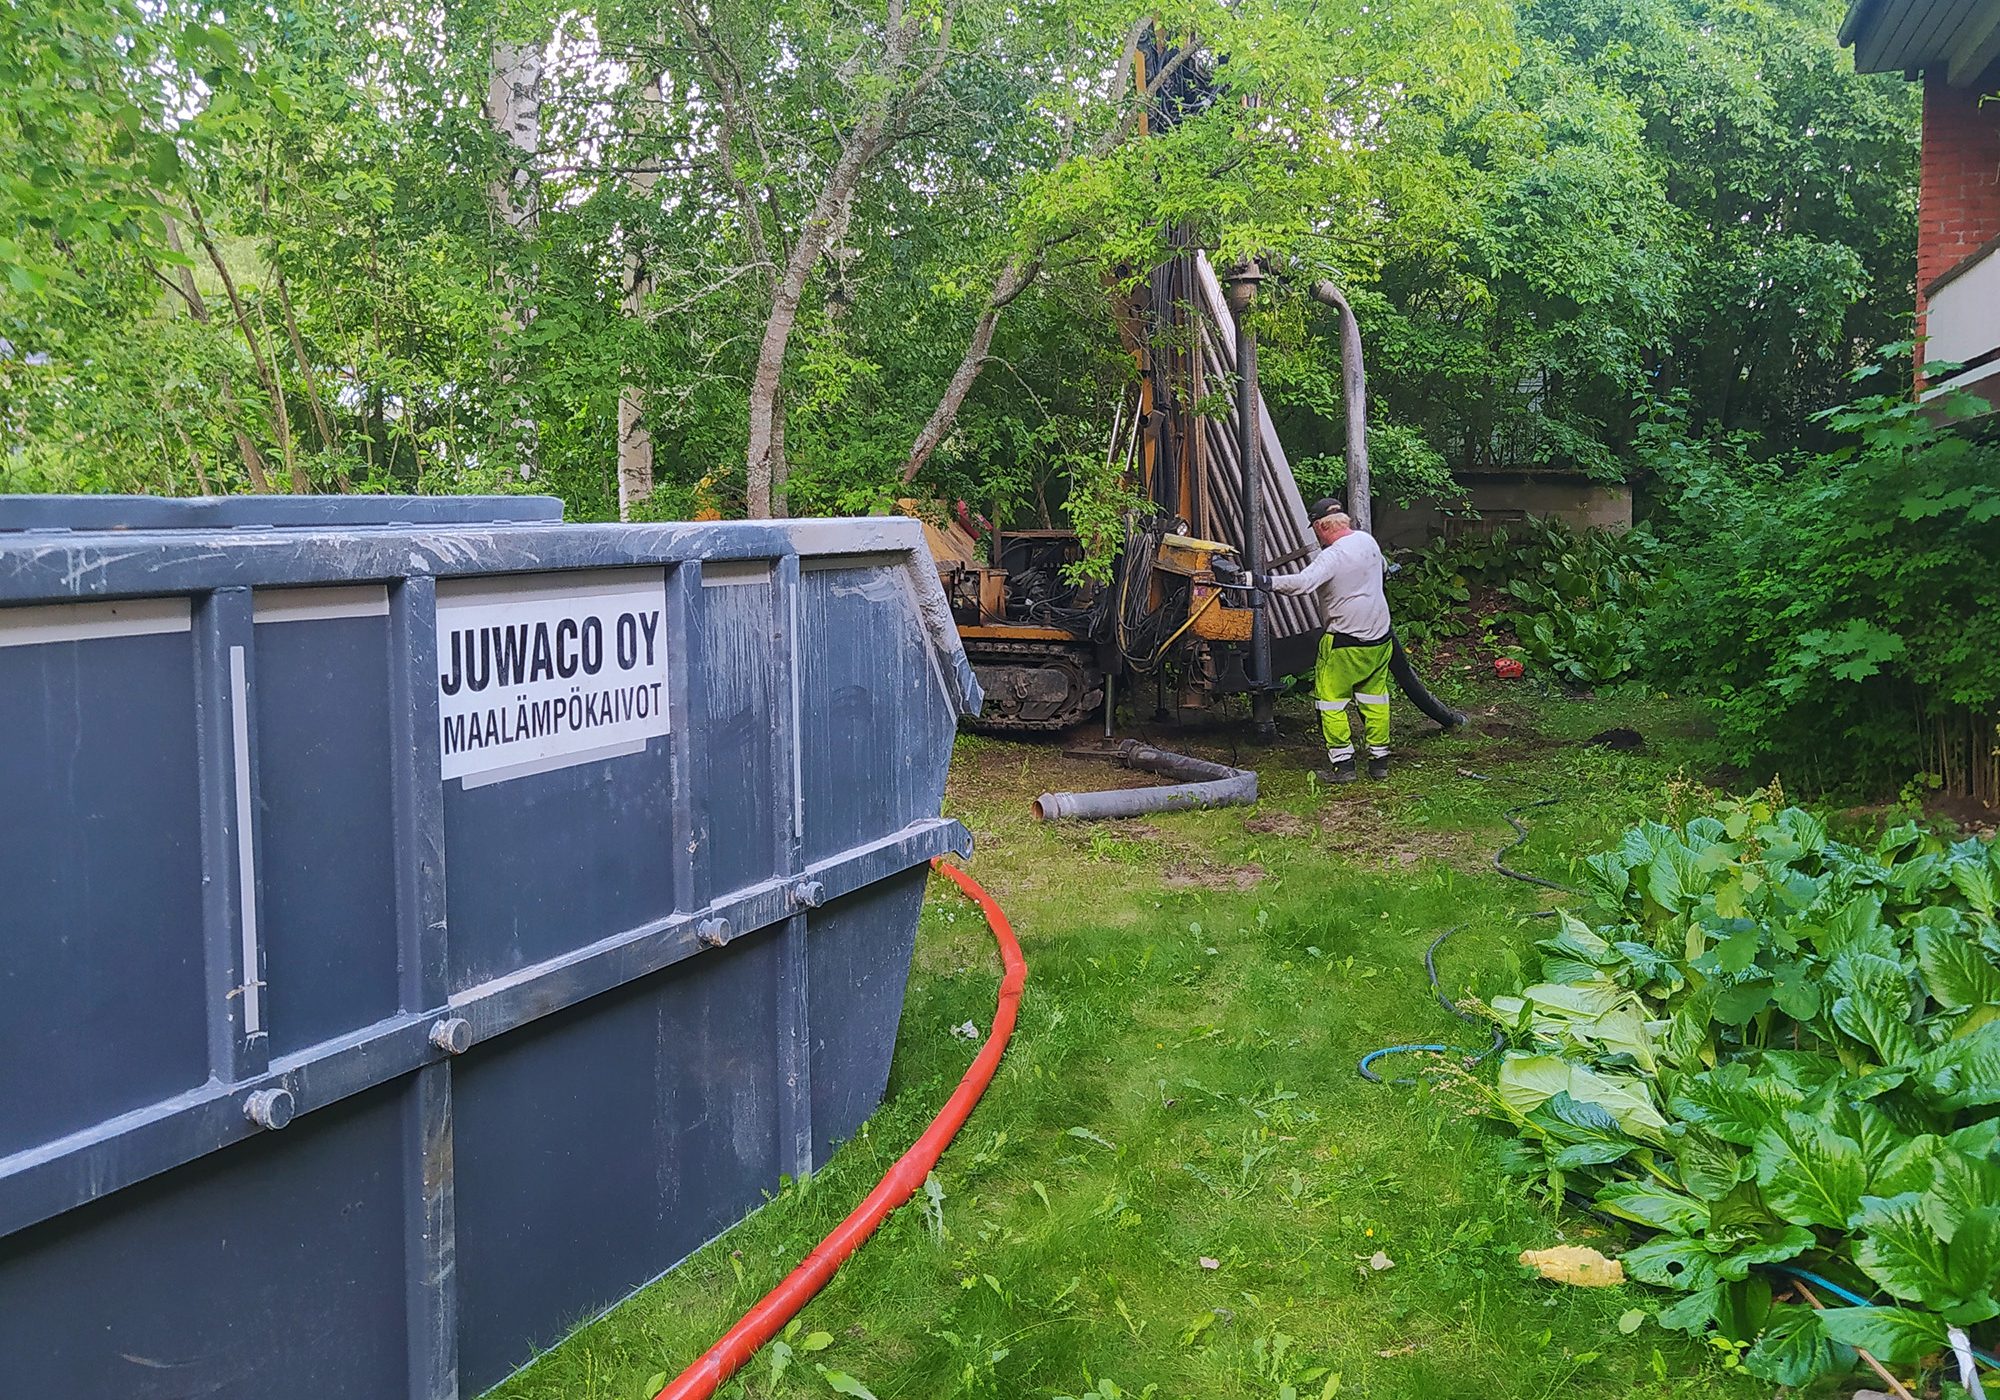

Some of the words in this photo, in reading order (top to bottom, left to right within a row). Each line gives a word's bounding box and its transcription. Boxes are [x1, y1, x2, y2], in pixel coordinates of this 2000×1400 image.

[441, 616, 602, 696] JUWACO
[616, 611, 660, 670] OY
[444, 682, 661, 755] MAALÄMPÖKAIVOT
